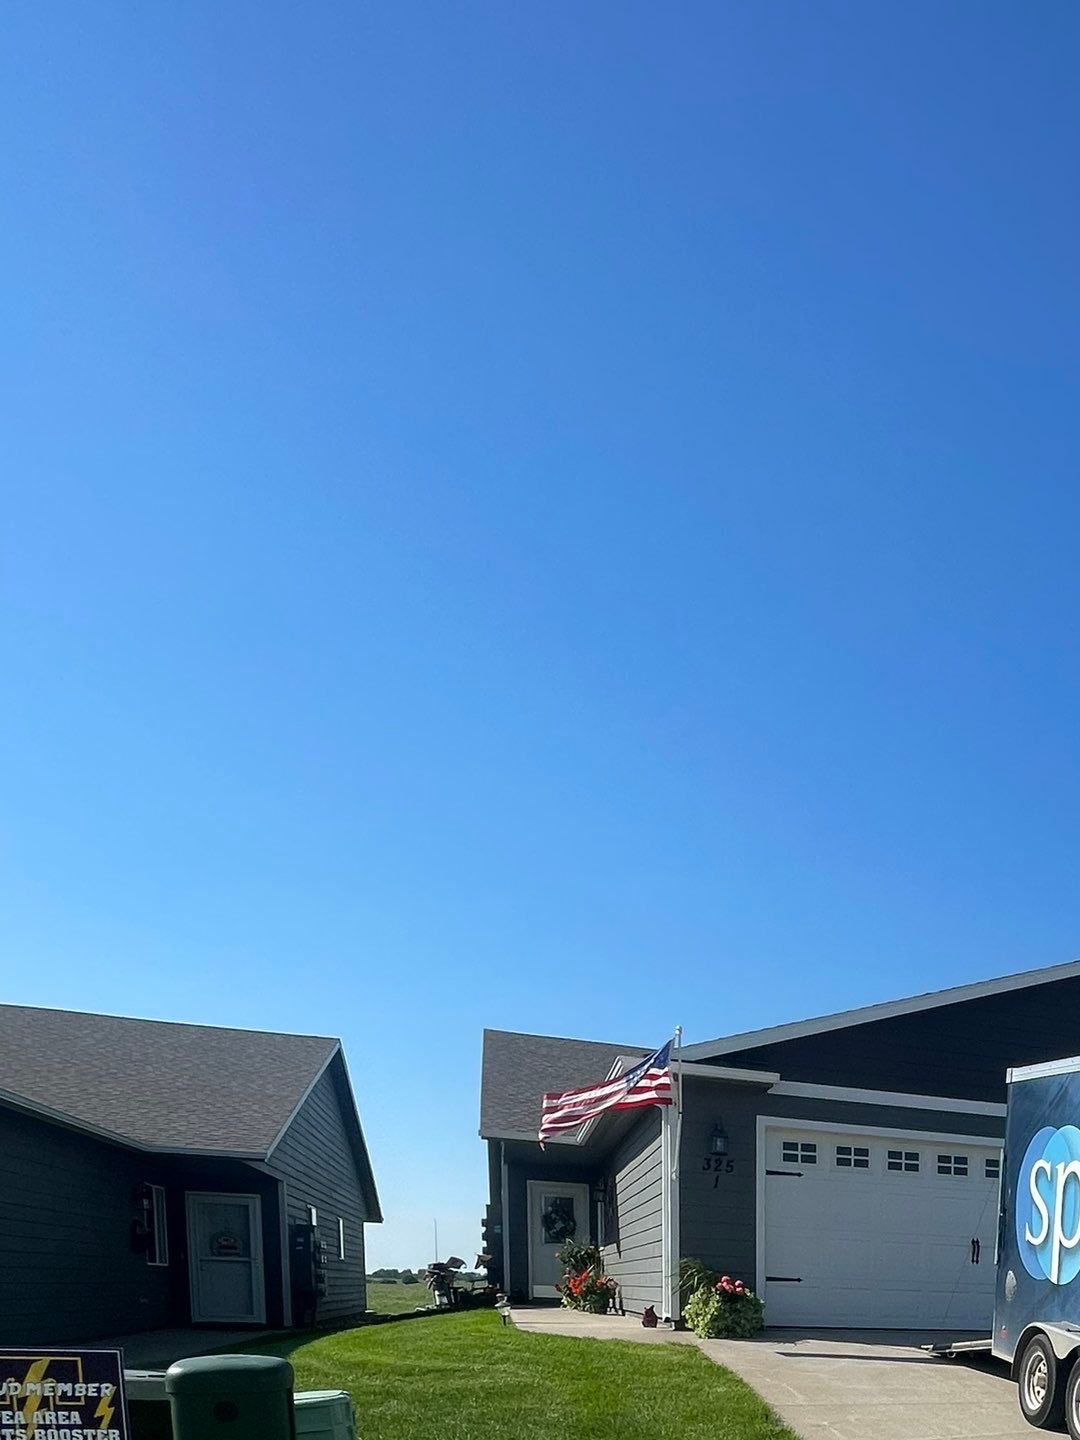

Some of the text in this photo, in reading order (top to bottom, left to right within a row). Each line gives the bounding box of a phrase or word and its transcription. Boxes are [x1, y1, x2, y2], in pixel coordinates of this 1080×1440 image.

[702, 1157, 735, 1174] 325
[25, 1382, 114, 1397] MEMBER
[0, 1410, 82, 1425] EA AREA
